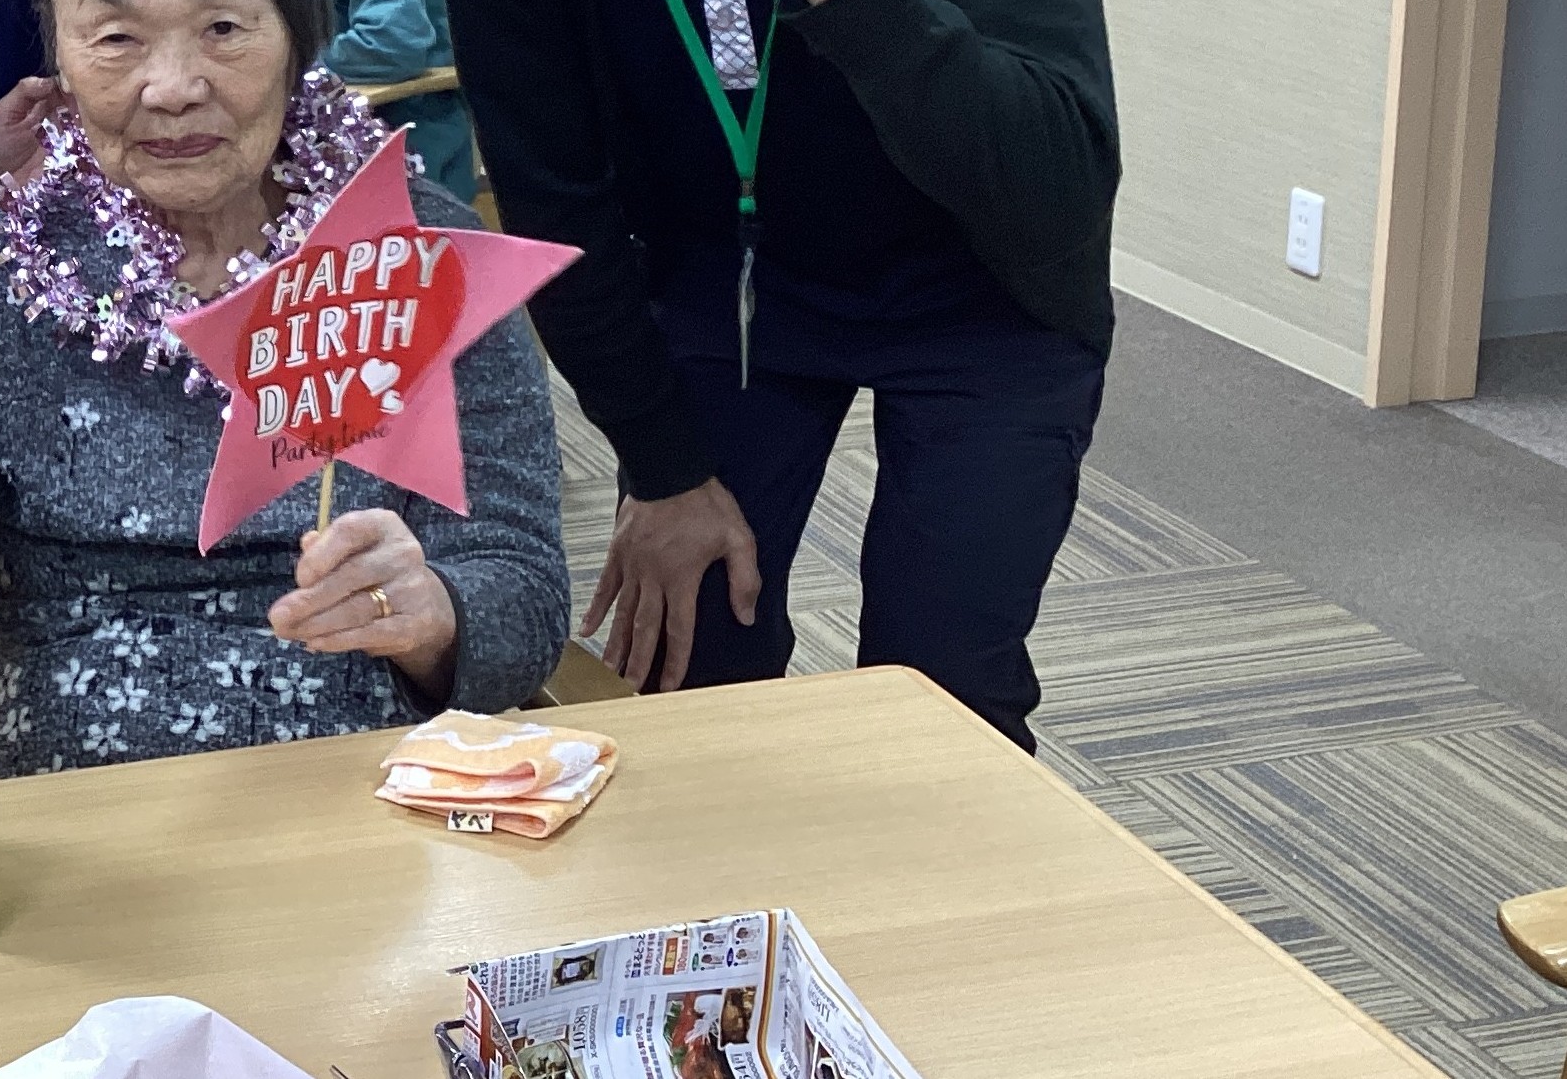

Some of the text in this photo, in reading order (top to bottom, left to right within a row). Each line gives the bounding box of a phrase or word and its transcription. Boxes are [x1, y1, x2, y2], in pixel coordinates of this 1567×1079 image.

[270, 235, 452, 318] HAPPY
[246, 298, 419, 380] BIRTH
[255, 366, 357, 439] DAY
